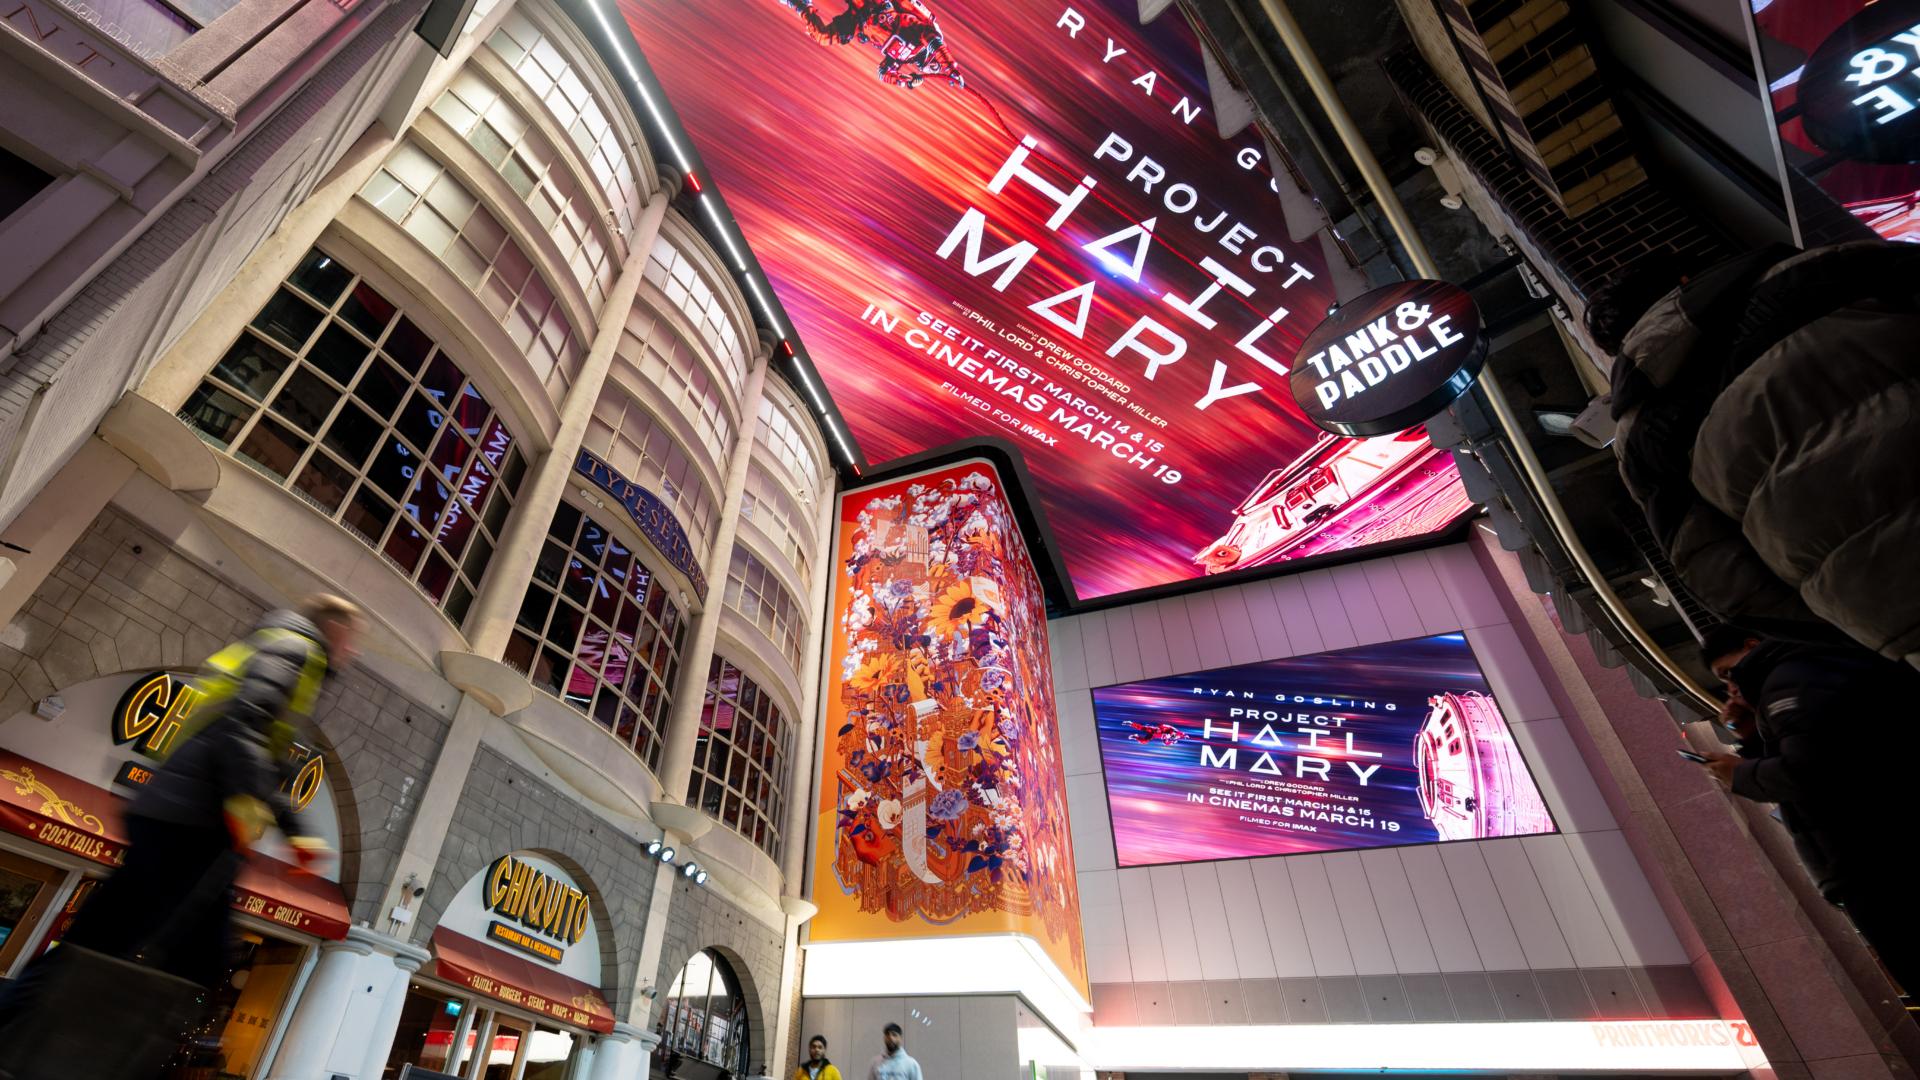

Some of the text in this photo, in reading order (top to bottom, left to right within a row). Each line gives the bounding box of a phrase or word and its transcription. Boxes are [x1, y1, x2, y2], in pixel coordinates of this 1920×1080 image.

[1056, 7, 1201, 125] RYAN
[1094, 132, 1314, 290] PROJECT
[986, 134, 1290, 376] HAIL
[935, 206, 1263, 411] MARY
[916, 311, 1165, 453] SEE IT FIRST MARCH 14 & 15
[968, 311, 1168, 429] PHIL LORD & CHRISTOPHER MILLER
[1036, 336, 1131, 394] DREW GODDARD
[1314, 314, 1464, 411] PADDLE
[861, 304, 1182, 485] IN CINEMAS MARCH 19
[940, 382, 1059, 447] FILMED FOR IMAX
[1193, 687, 1397, 711] RYAN GOSLING
[1230, 707, 1346, 727] PROJECT
[1203, 718, 1383, 758] HAIL
[1200, 745, 1382, 786] MARY
[1264, 779, 1285, 787] DREW
[1286, 782, 1325, 792] GODDARD
[1209, 787, 1232, 797] SEE
[1247, 792, 1283, 803] FIRST
[1284, 798, 1330, 811] MARCH
[1332, 805, 1345, 813] 14
[1347, 807, 1356, 815] &
[1359, 808, 1371, 816] 15
[1229, 780, 1245, 788] PHIL
[1245, 782, 1266, 790] LORD
[1274, 786, 1328, 798] CHRISTOPHER
[1330, 793, 1359, 802] MILLER
[1186, 792, 1400, 832] IN CINEMAS MARCH 19
[1239, 815, 1317, 833] FILMED FOR IMAX
[38, 822, 104, 857] COCKTAILS
[244, 895, 303, 926] FISH GRILLS
[491, 854, 590, 943] CHIQUITO
[498, 985, 522, 1003] BURGERS
[527, 995, 546, 1011] STEAKS
[551, 1003, 569, 1018] WRAPS
[1592, 1023, 1730, 1047] PRINTWORKS
